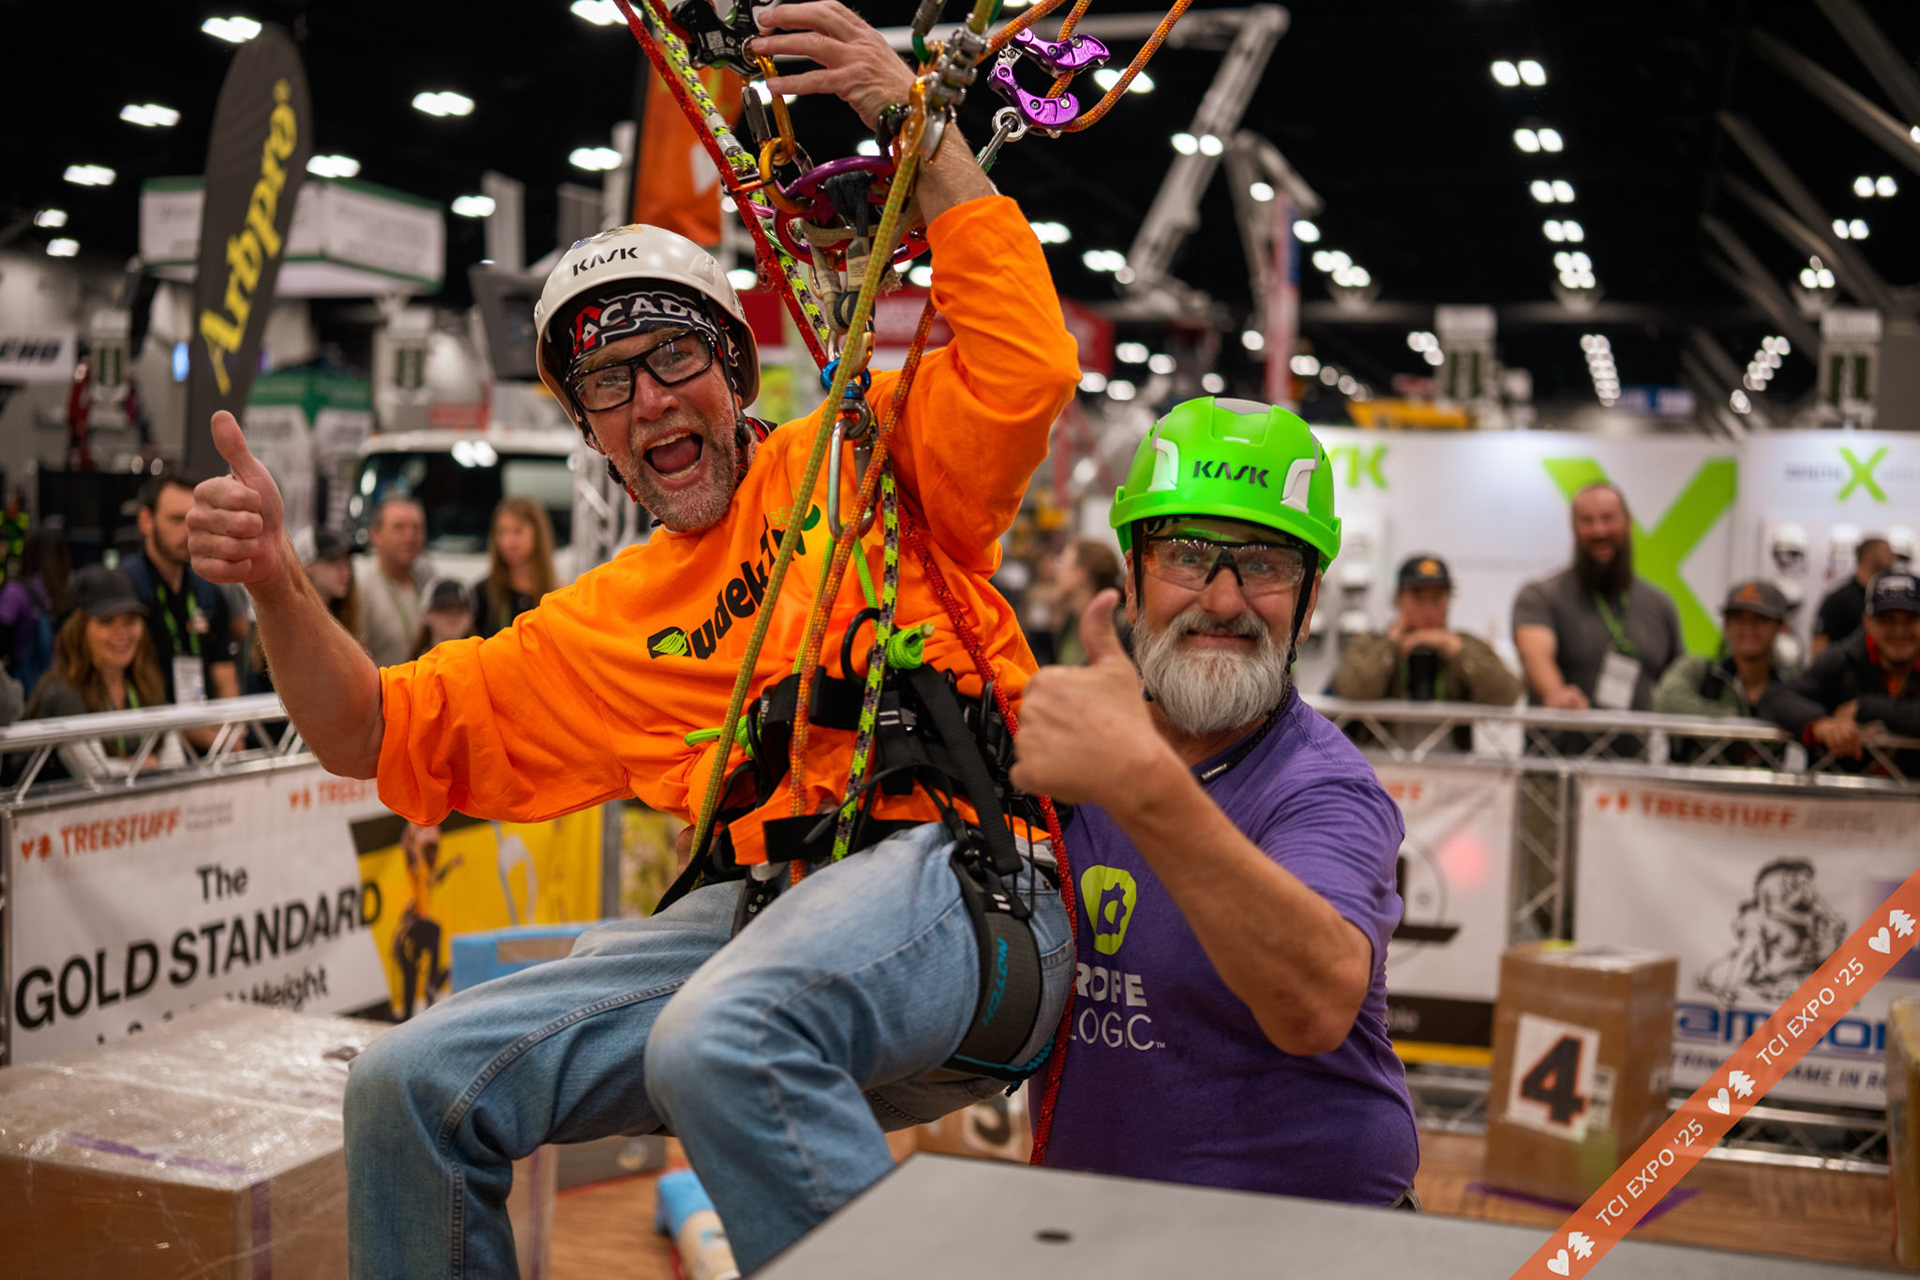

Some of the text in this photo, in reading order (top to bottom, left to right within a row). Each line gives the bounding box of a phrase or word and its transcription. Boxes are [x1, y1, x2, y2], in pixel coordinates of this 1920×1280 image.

[572, 246, 639, 277] KASK
[1193, 460, 1270, 488] KASK
[60, 807, 182, 857] TREESTUFF
[1640, 795, 1796, 829] TREESTUFF
[196, 863, 249, 901] The
[14, 878, 383, 1031] GOLD STANDARD
[1075, 962, 1148, 1008] ROPE
[1519, 1033, 1588, 1129] 4
